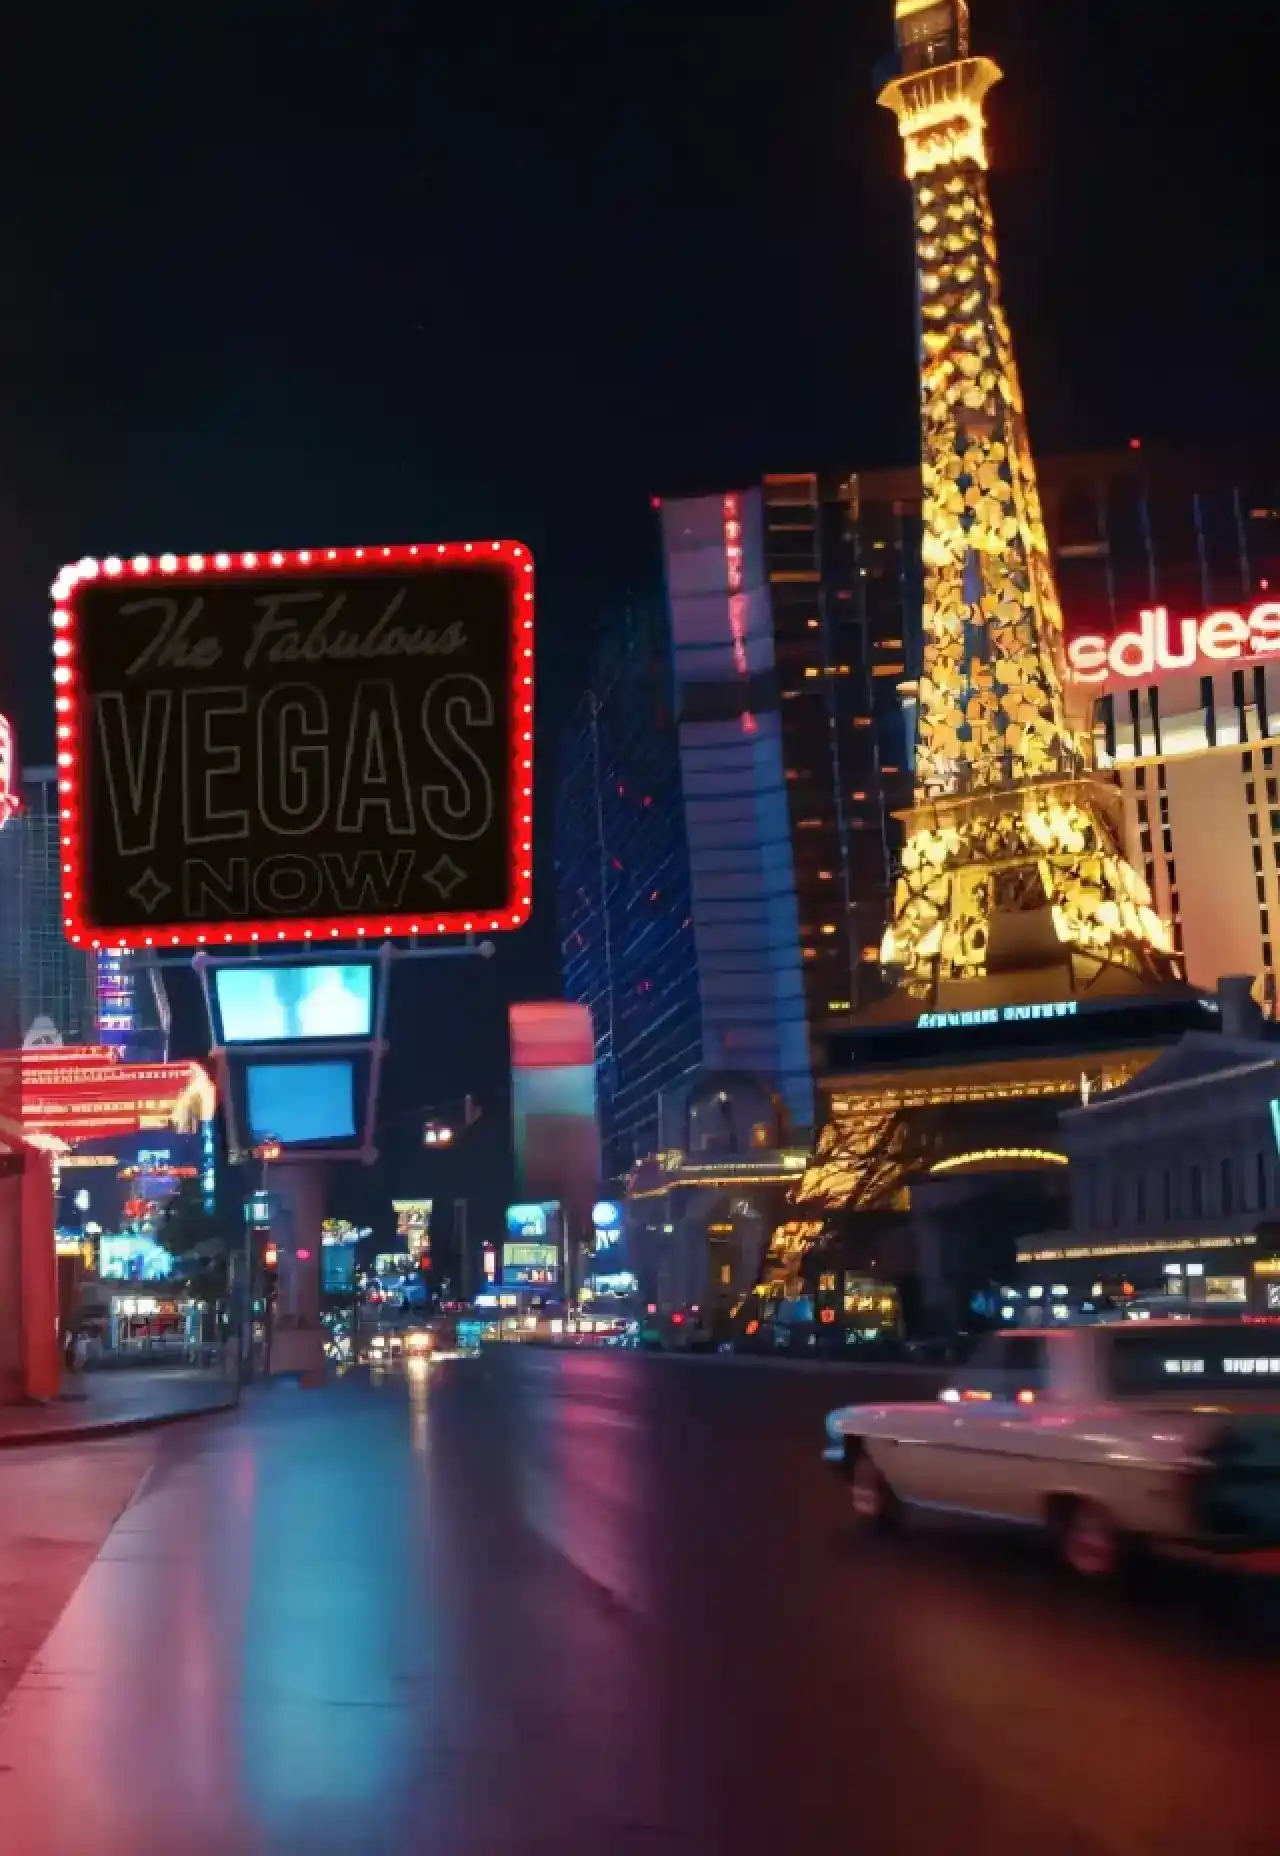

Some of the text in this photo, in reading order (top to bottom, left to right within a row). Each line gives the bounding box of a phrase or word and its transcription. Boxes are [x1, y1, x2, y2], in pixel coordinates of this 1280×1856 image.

[118, 588, 467, 675] The Fabulous
[95, 673, 494, 856] VEGAS
[184, 849, 416, 917] NOW
